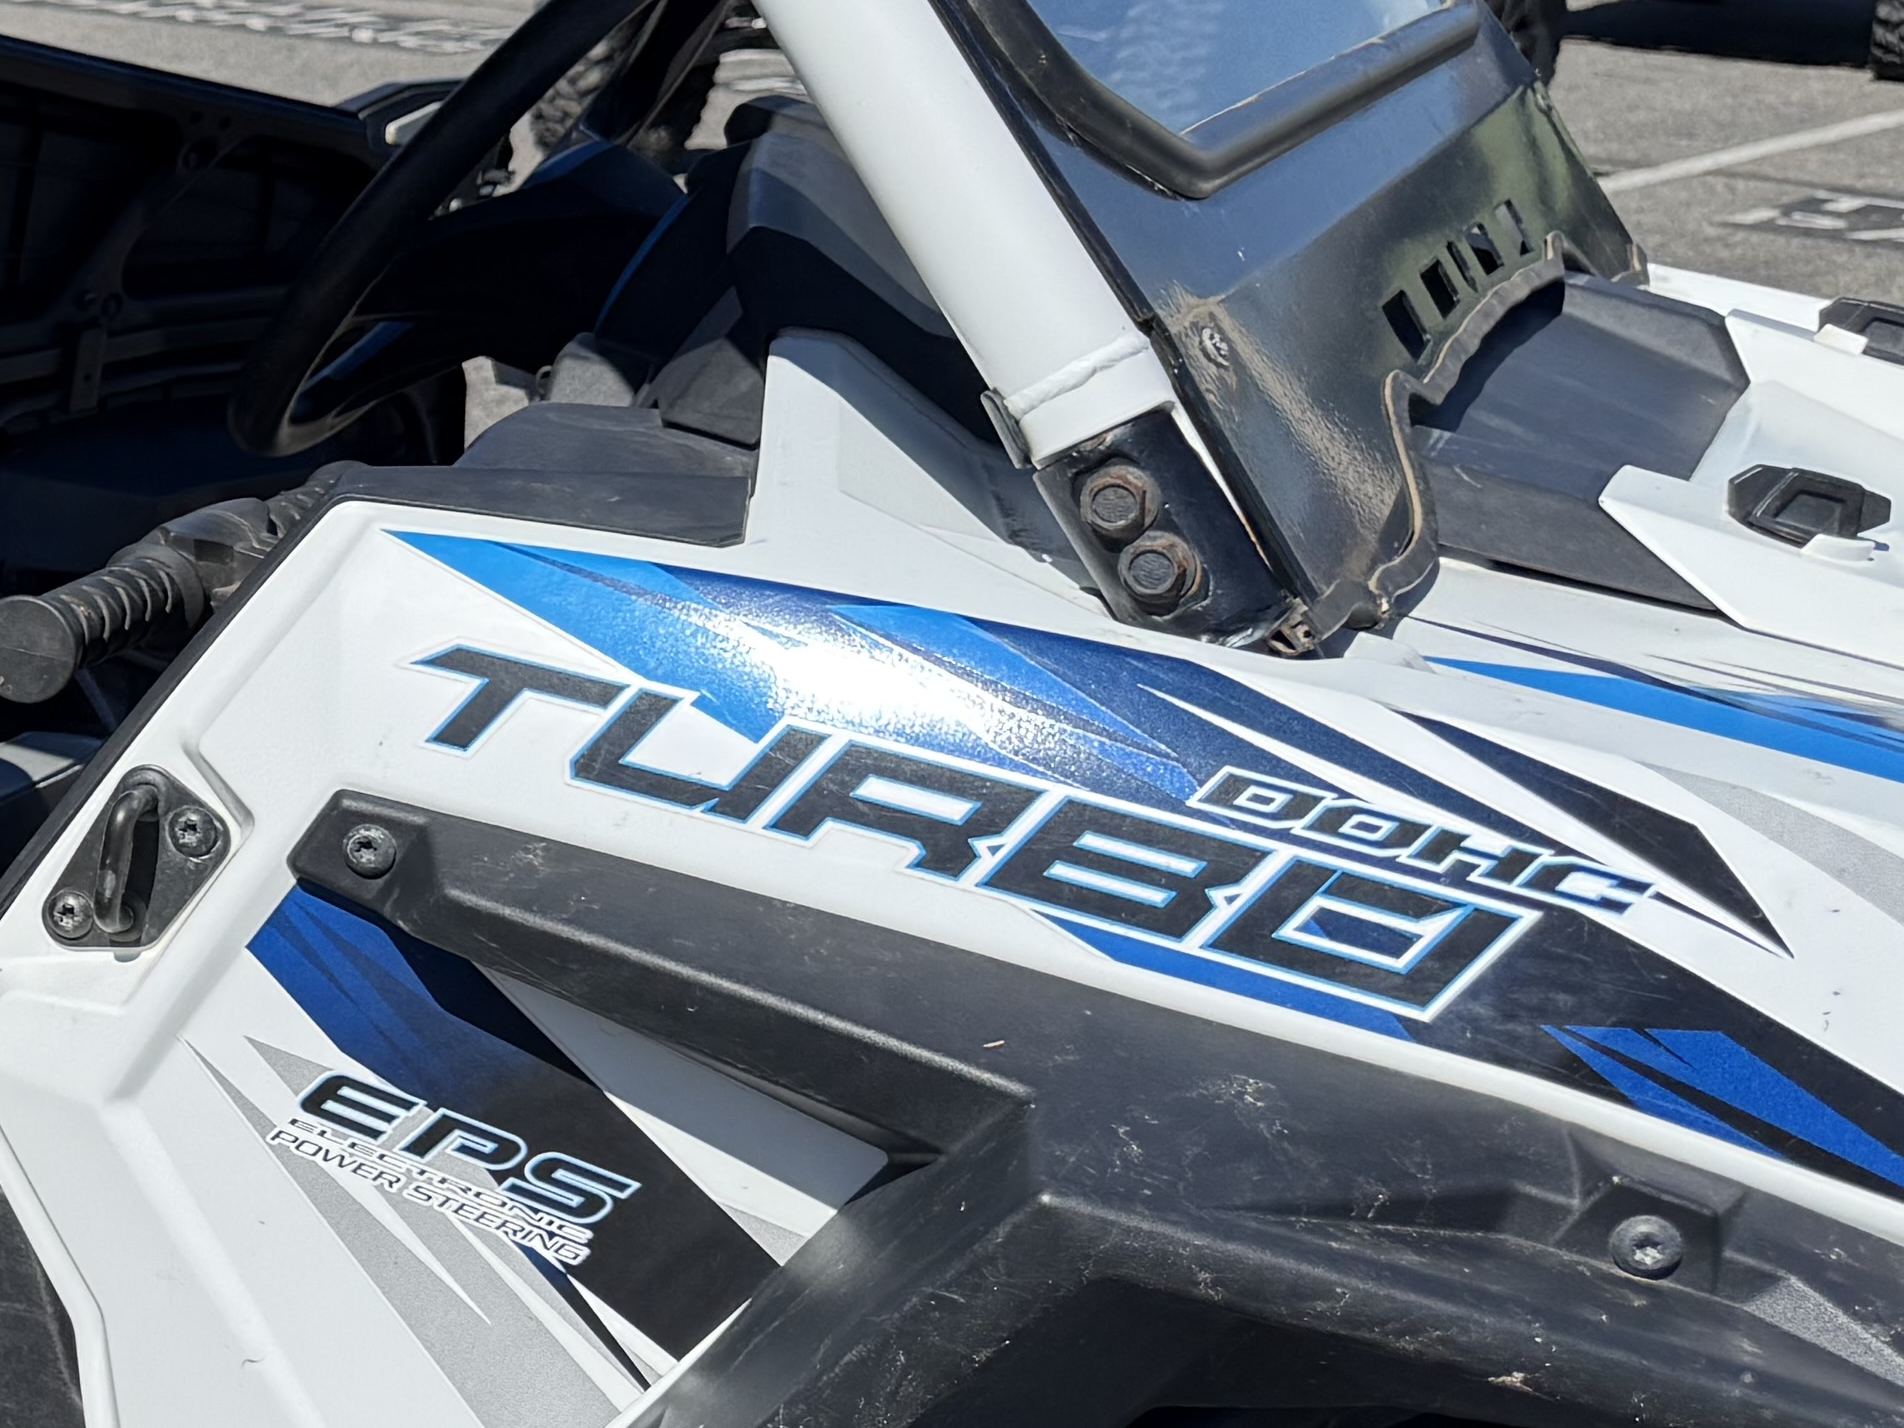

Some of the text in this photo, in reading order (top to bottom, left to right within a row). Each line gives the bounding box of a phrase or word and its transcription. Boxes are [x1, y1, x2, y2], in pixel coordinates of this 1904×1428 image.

[408, 642, 1534, 1016] TURBO
[1190, 768, 1655, 916] DOHC
[267, 1124, 591, 1265] POWER STEERING
[288, 1117, 593, 1244] ELECTRONIC
[296, 1071, 643, 1225] EPS
